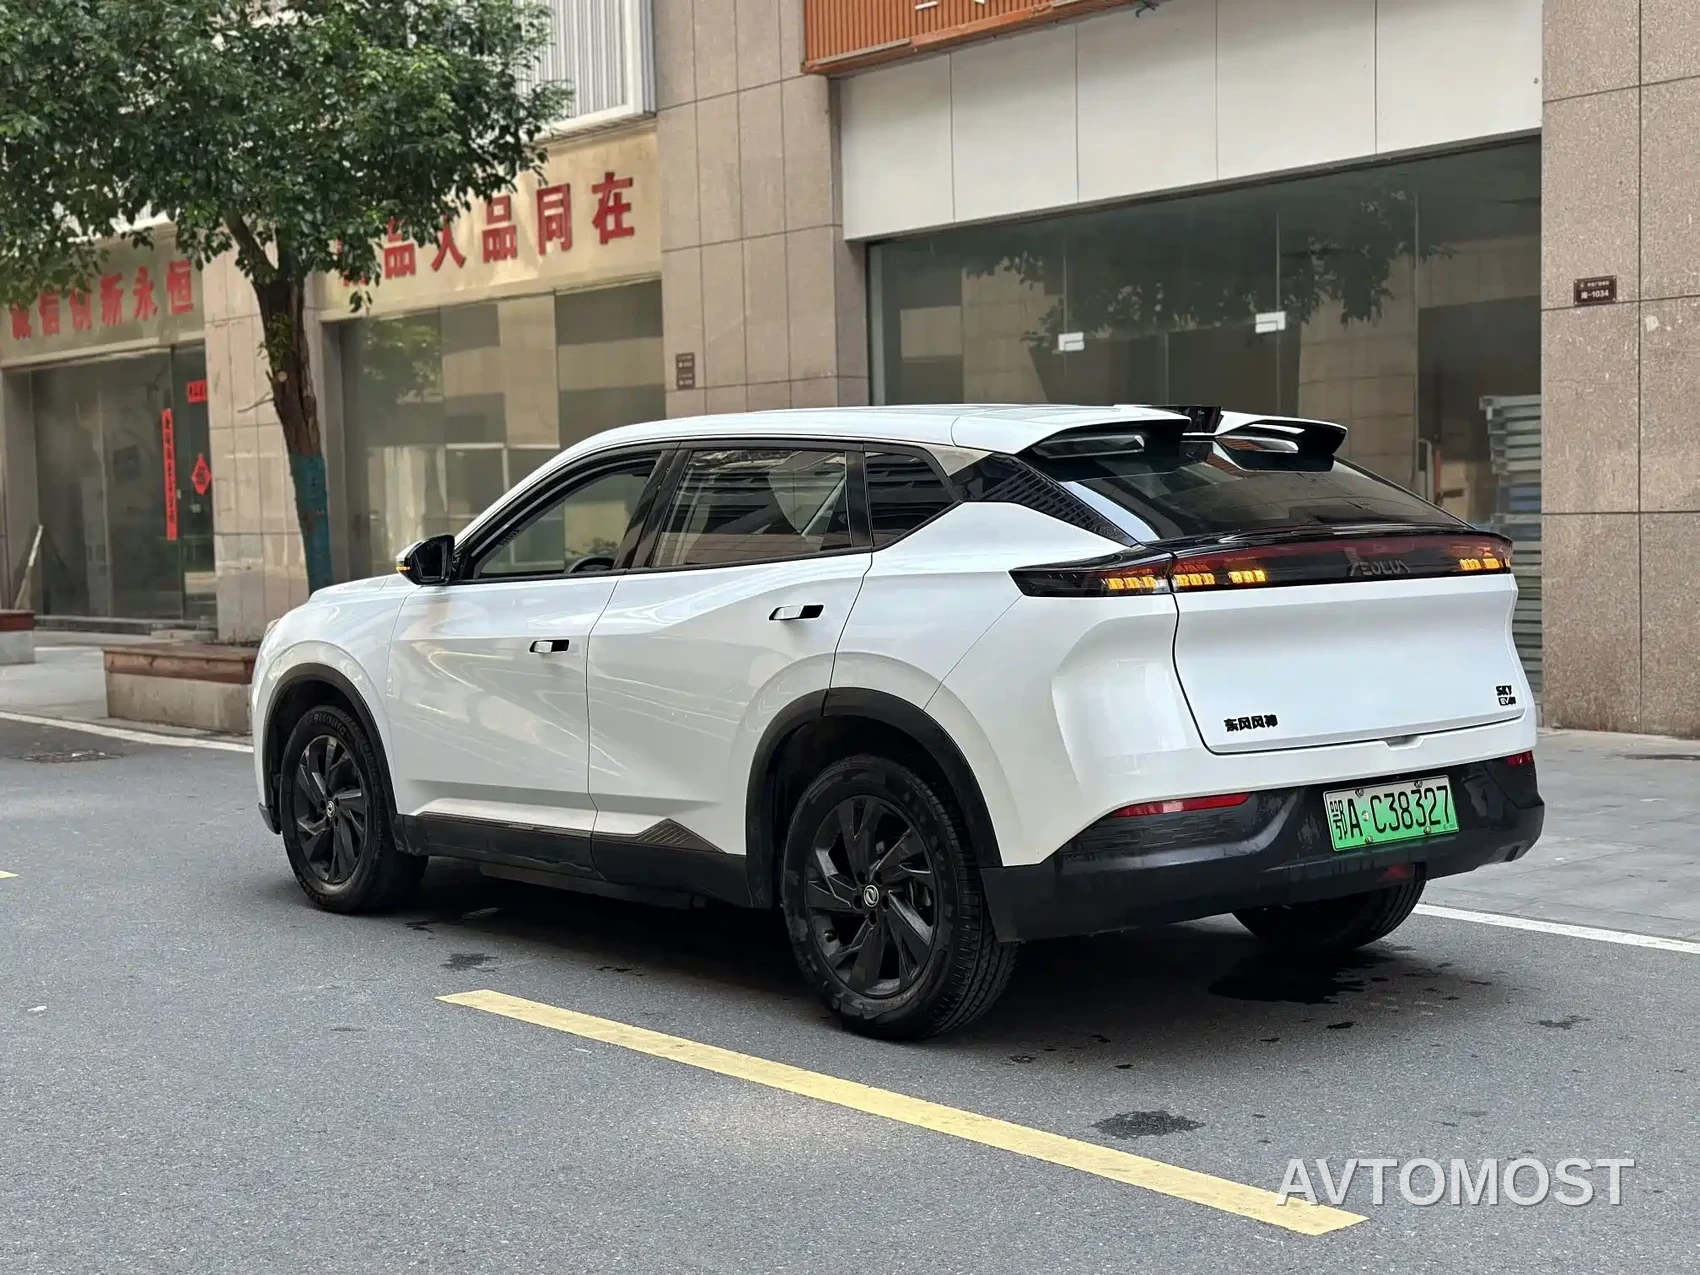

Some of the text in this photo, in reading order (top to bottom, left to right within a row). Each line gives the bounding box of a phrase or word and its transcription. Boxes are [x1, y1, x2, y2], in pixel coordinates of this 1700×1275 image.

[336, 172, 635, 288] 品人品同在
